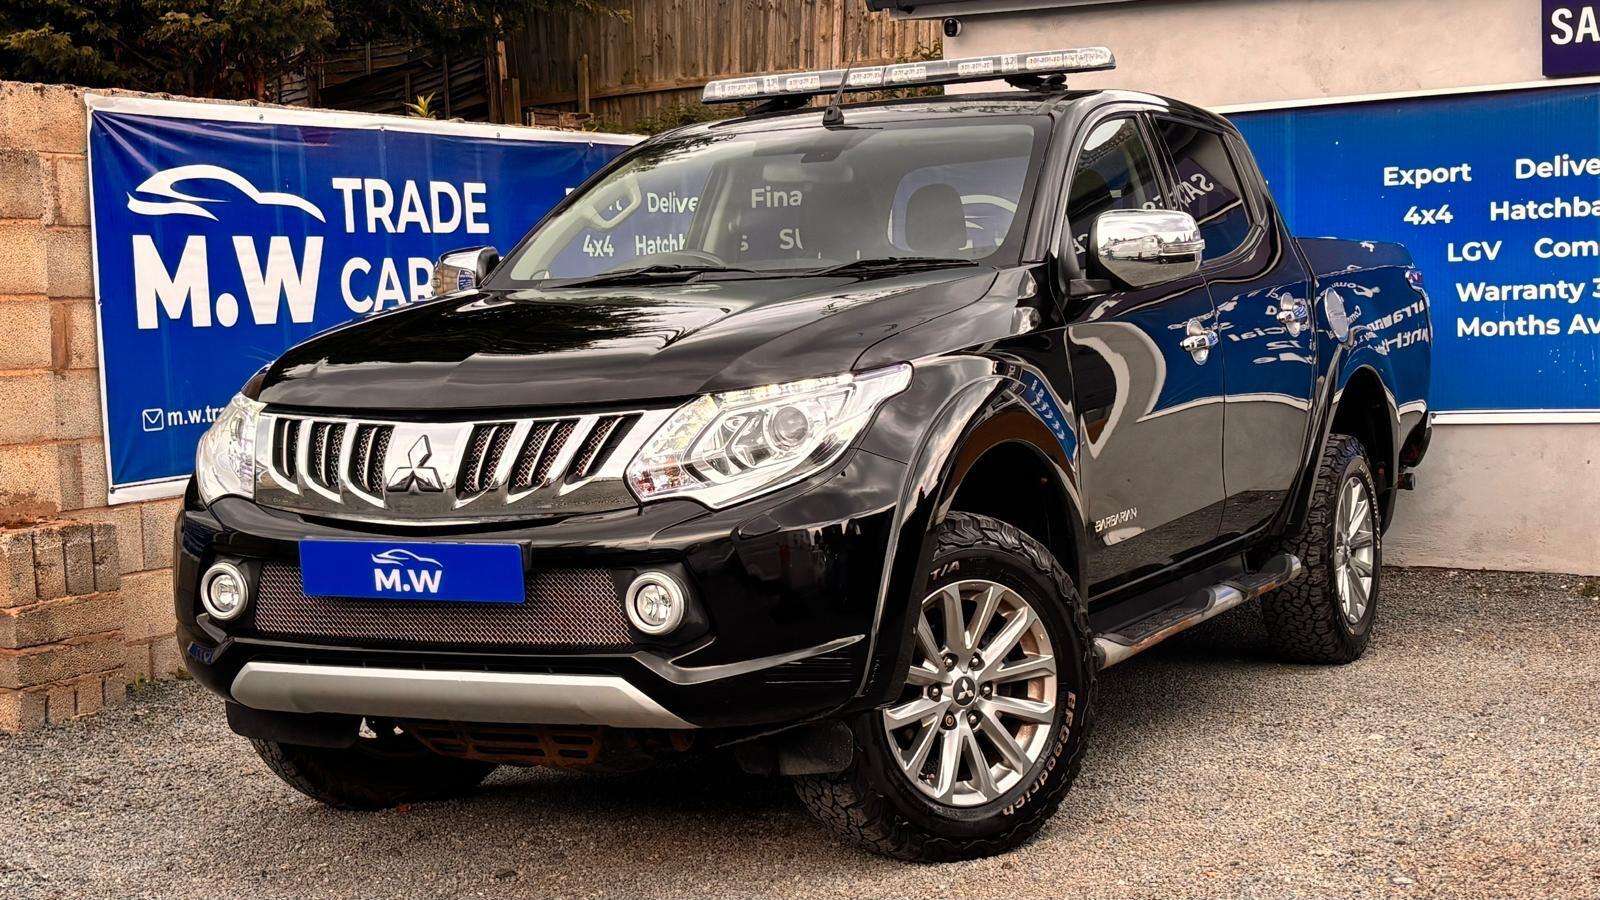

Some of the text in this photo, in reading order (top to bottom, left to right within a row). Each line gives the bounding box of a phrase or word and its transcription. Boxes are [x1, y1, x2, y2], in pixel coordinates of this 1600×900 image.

[1383, 154, 1600, 189] Export Delive
[332, 177, 490, 234] TRADE
[647, 190, 699, 213] Delive
[751, 185, 802, 208] Fina
[1403, 204, 1453, 225] 4x4
[582, 234, 614, 257] 4x4
[1447, 237, 1599, 262] LGV Com
[132, 234, 324, 330] M.W
[1455, 280, 1586, 304] Warranty
[1456, 314, 1560, 338] Months
[167, 405, 225, 426] m.w.tr
[1094, 507, 1138, 533] BARBARIAN
[374, 568, 442, 593] M.W
